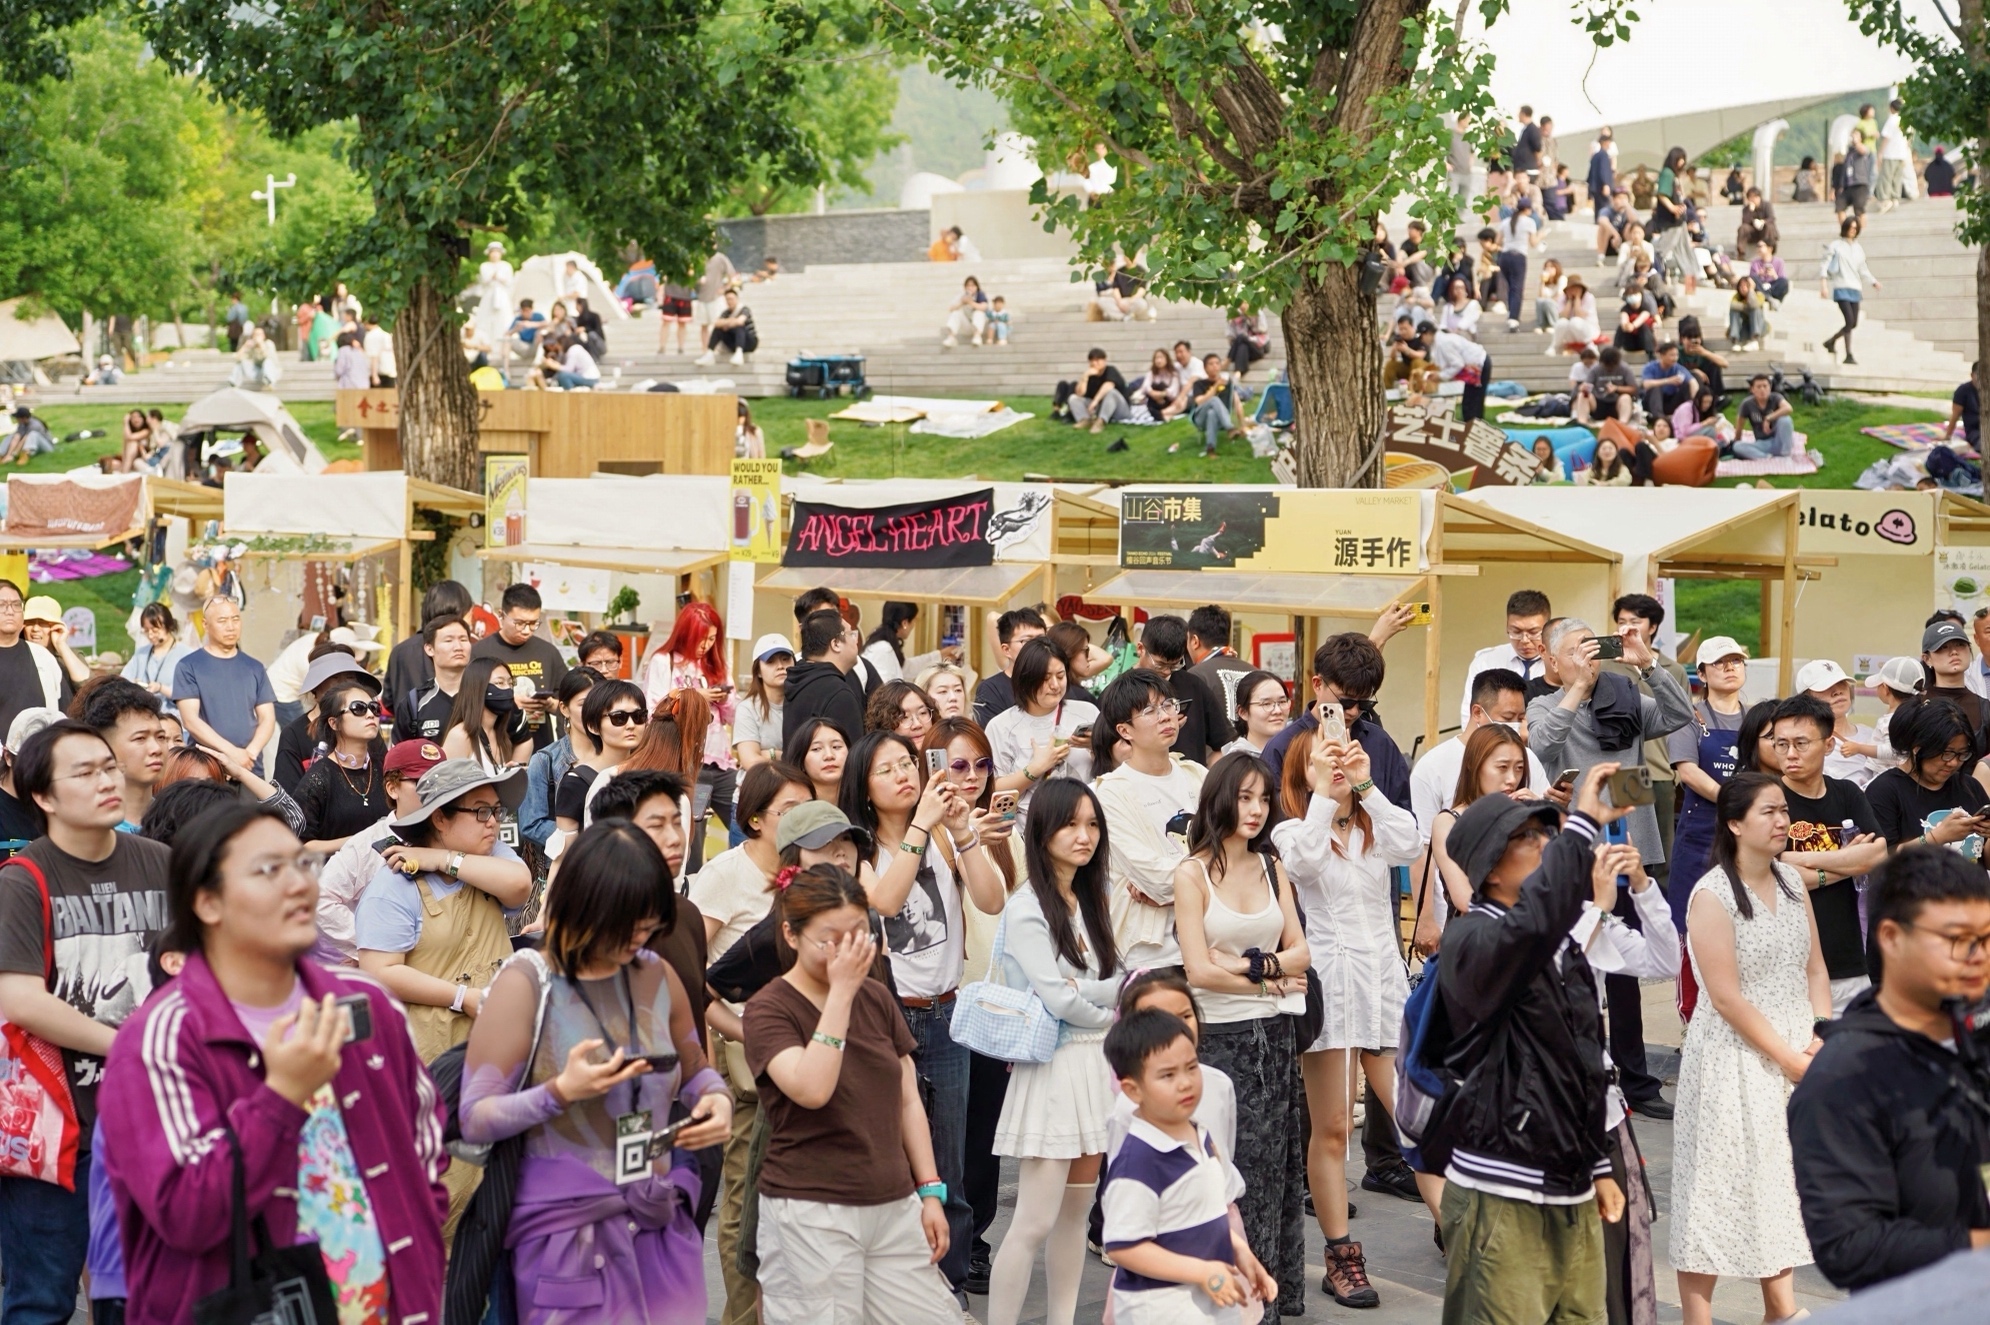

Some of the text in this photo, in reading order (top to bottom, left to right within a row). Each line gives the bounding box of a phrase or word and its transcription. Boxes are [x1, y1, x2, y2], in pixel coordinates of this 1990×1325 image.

[733, 463, 778, 473] WOULD YOU
[1355, 497, 1412, 505] VALLEY MARKET
[1126, 497, 1202, 522] 山谷市集
[1334, 537, 1411, 568] 源手作
[91, 882, 117, 894] ALIEN
